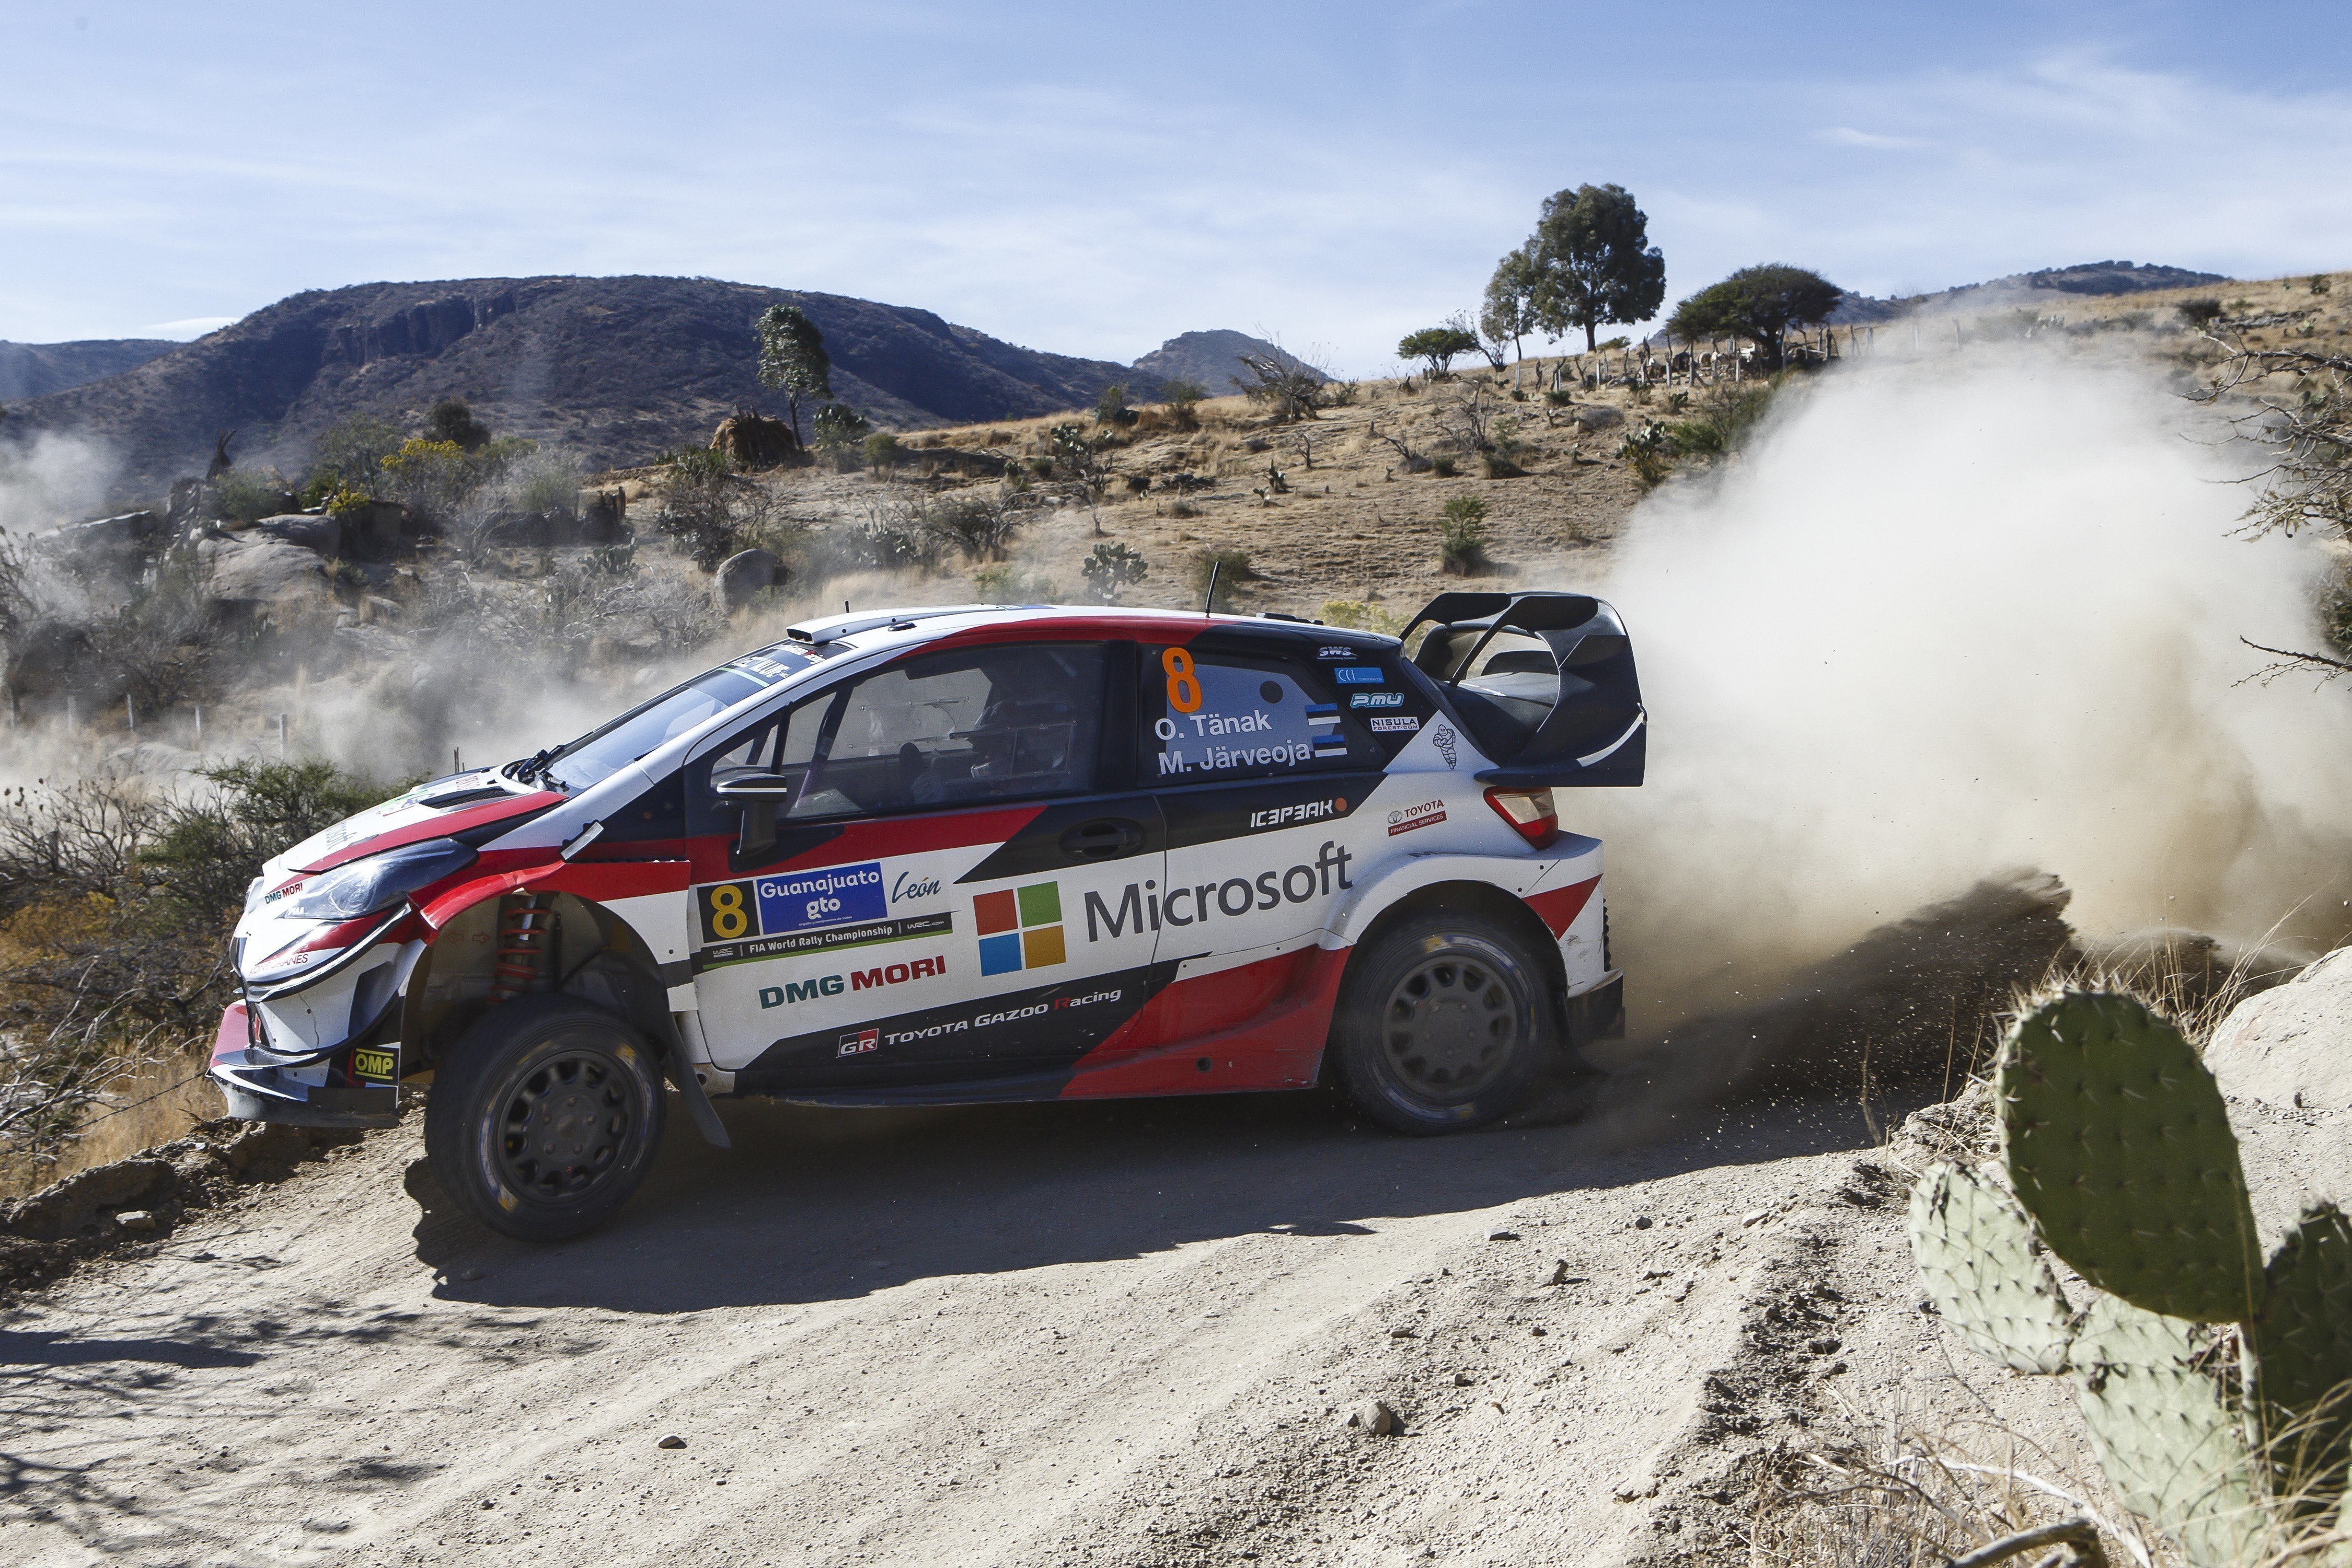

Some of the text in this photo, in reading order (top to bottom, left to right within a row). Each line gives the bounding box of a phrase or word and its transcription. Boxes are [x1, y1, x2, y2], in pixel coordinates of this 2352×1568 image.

[1319, 646, 1352, 656] SWS
[1162, 647, 1202, 713] 8
[1155, 710, 1272, 740] O. Tänak
[1158, 740, 1311, 774] M. Järveoja
[1403, 799, 1445, 817] TOYOTA
[1390, 814, 1444, 834] FINANCIAL SERVICES
[264, 882, 303, 904] DMG MORI
[760, 871, 880, 898] Guanajuato
[891, 871, 941, 903] León
[1084, 840, 1353, 943] Microsoft
[711, 885, 748, 938] 8
[806, 897, 841, 920] gto
[750, 925, 892, 953] FIA World Rally Championship
[758, 955, 946, 1009] DMG MORI
[885, 989, 1122, 1045] TOYOTA GAZOO Racing
[840, 1038, 875, 1055] GR
[356, 1053, 394, 1074] OMP
